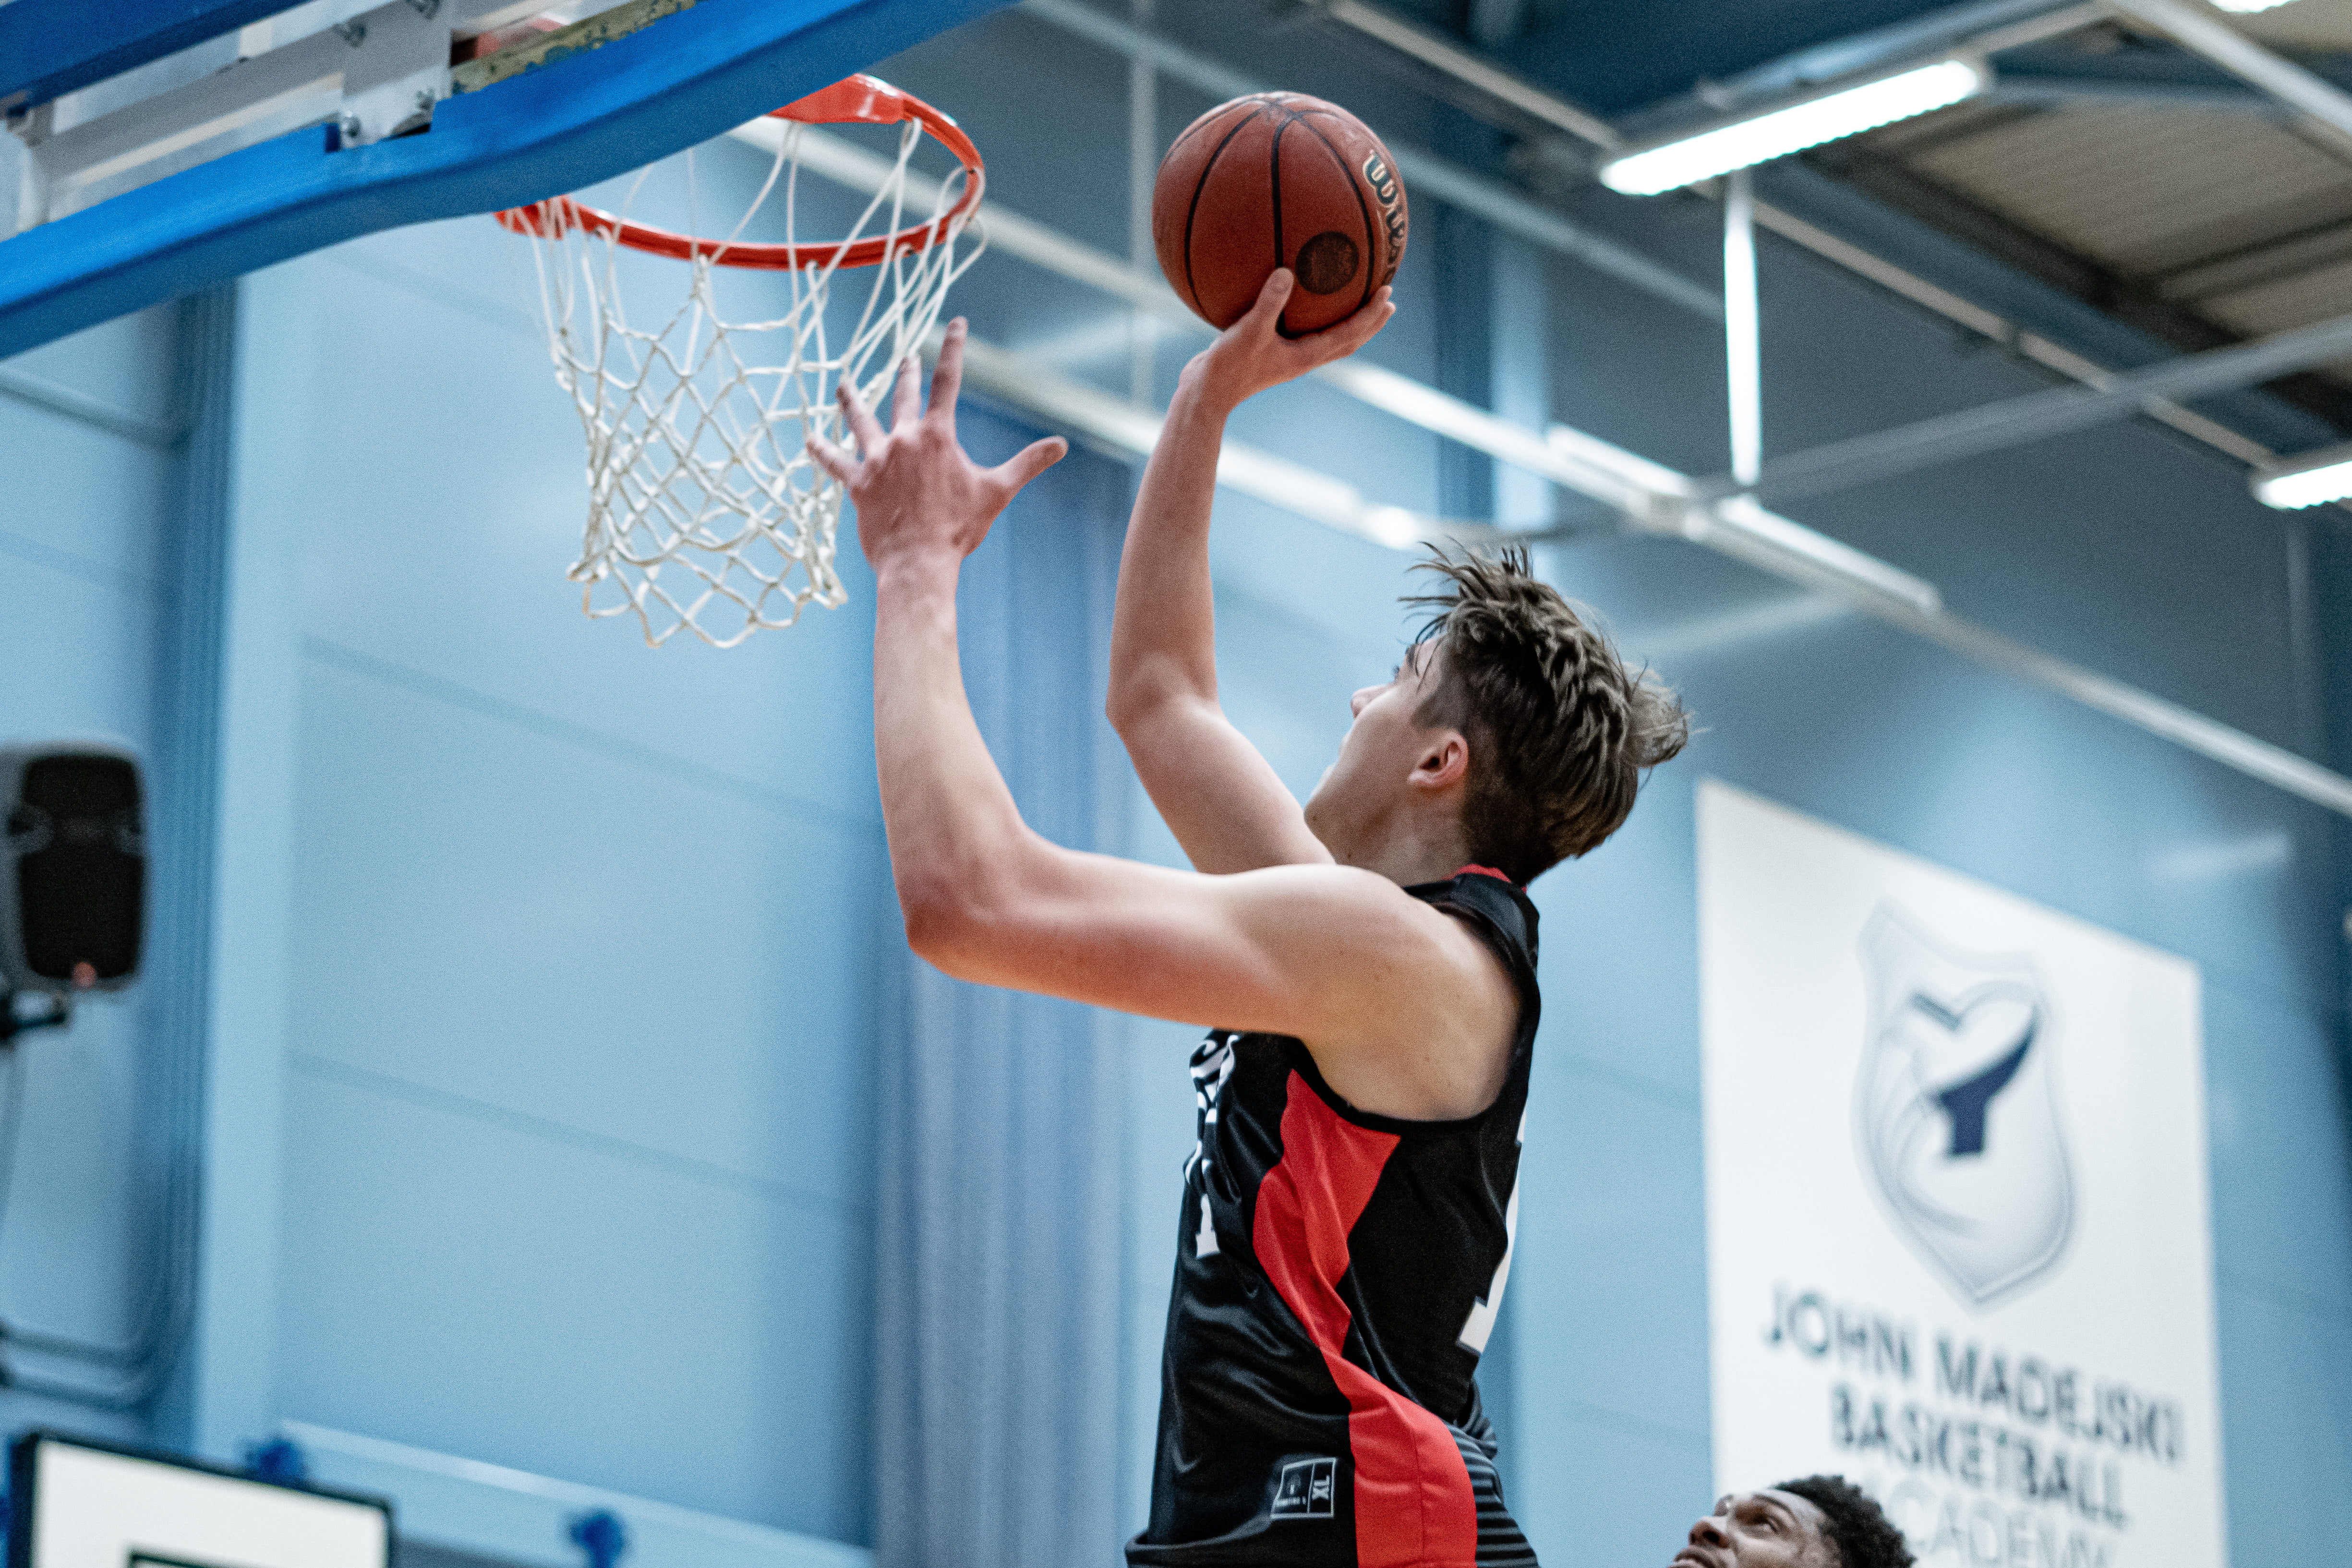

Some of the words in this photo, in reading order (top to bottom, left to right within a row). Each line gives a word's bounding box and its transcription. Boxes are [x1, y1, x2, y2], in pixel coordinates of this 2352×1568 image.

[1763, 1283, 1912, 1379] JOHN
[1934, 1332, 2183, 1463] MADEJSKI
[1831, 1382, 2127, 1527] BASKETBALL
